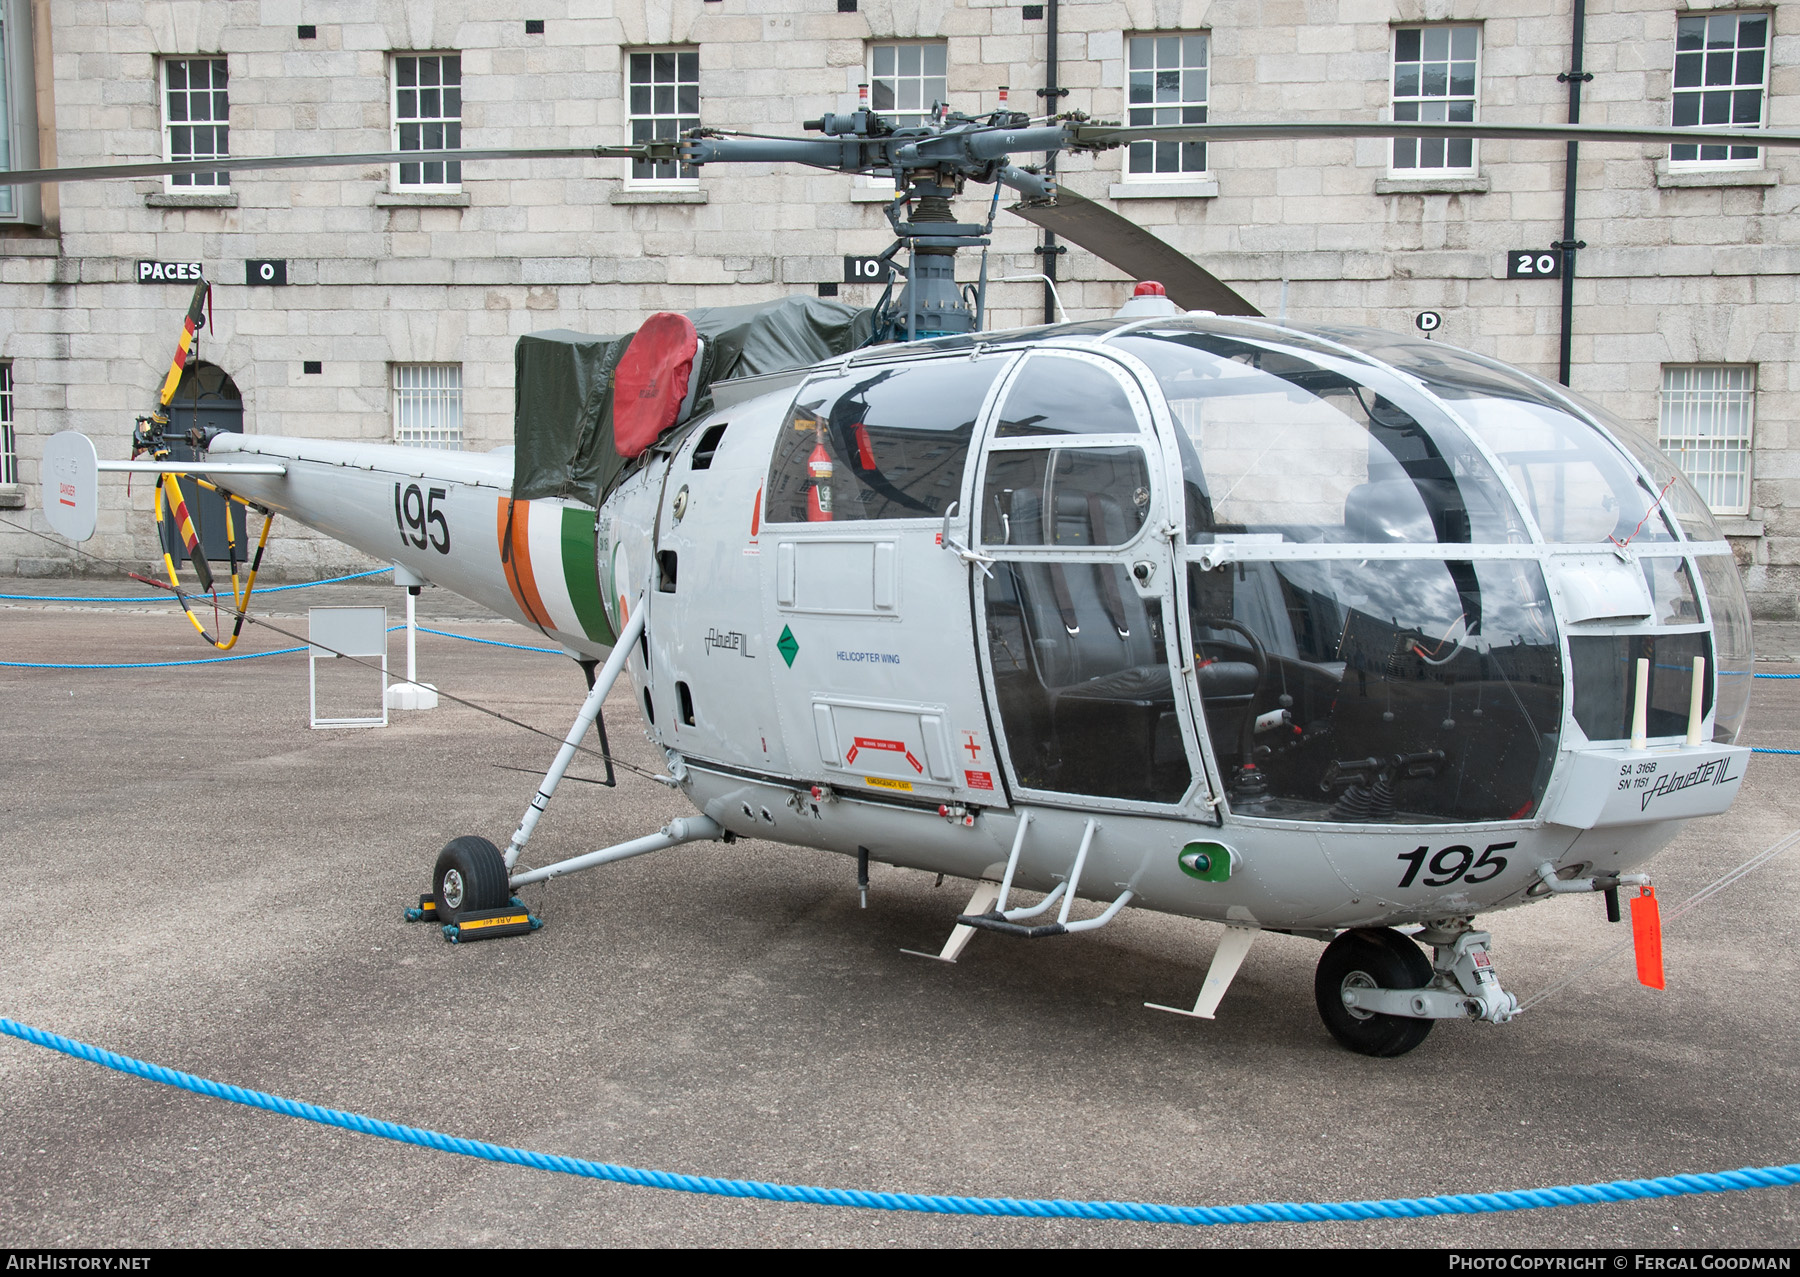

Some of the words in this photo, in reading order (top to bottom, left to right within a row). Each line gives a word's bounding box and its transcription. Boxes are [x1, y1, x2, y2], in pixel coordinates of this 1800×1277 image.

[139, 262, 201, 279] PACES
[855, 260, 880, 277] 10
[1517, 254, 1555, 274] 20
[1421, 313, 1438, 330] D
[395, 482, 450, 555] 195
[836, 651, 880, 663] HELICOPTER
[880, 653, 900, 664] WING
[1620, 765, 1632, 776] SA
[1636, 762, 1657, 775] 316B
[867, 777, 897, 788] EMERGENCY
[1617, 779, 1631, 791] SN
[1633, 777, 1650, 789] 1151
[1397, 841, 1517, 888] 195
